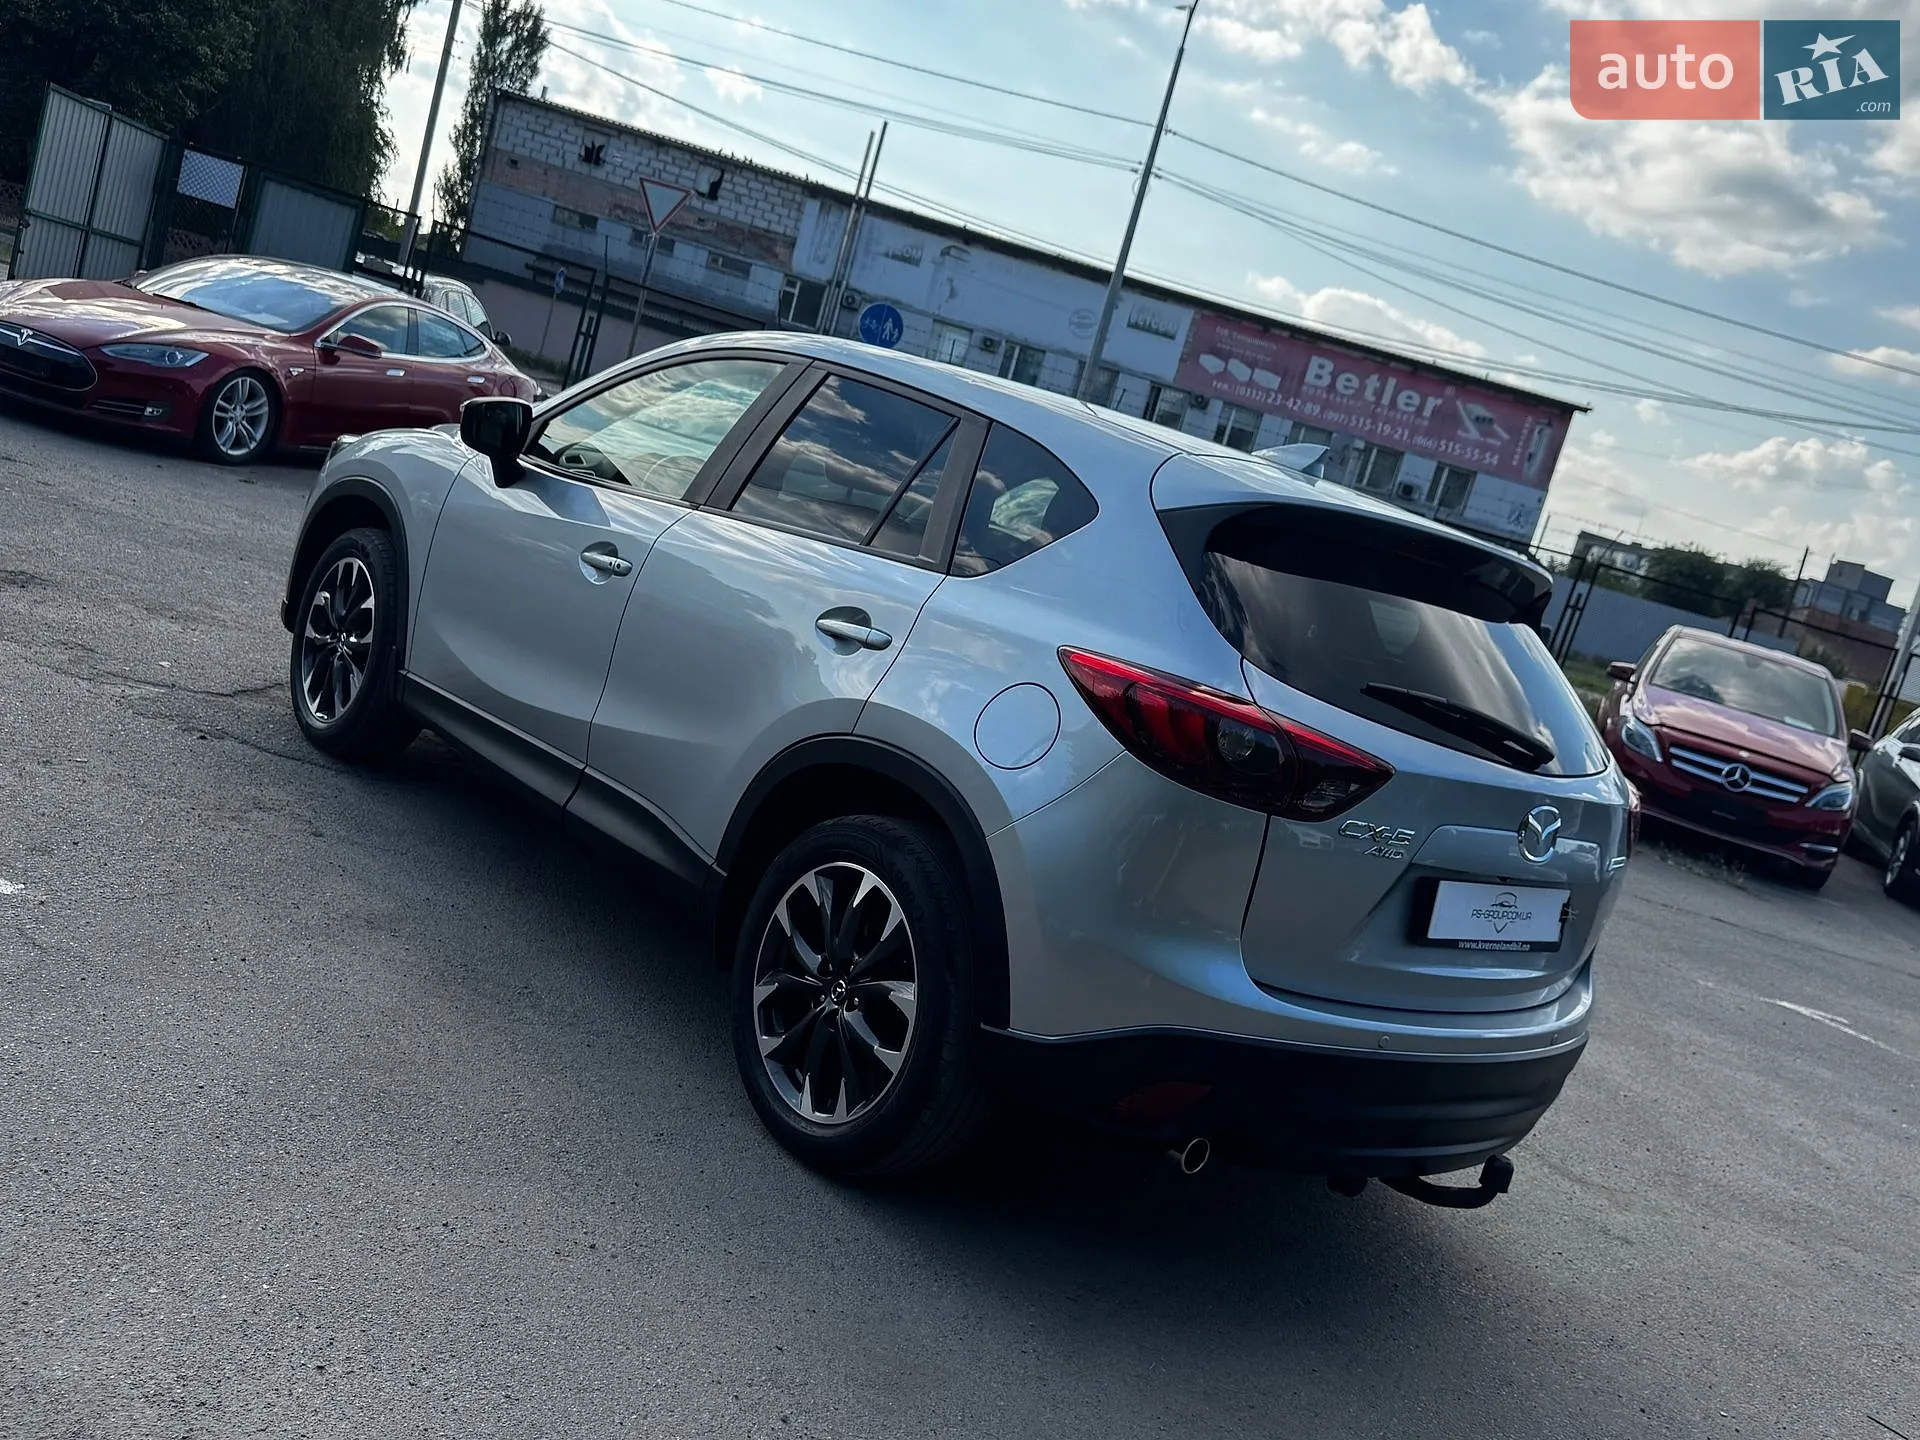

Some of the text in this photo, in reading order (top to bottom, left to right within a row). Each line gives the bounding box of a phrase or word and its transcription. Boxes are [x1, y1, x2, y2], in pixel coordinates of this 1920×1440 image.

[1304, 355, 1443, 417] Betler
[1338, 819, 1415, 846] CX-5
[1458, 940, 1531, 952] www.kvernelandbil.no
